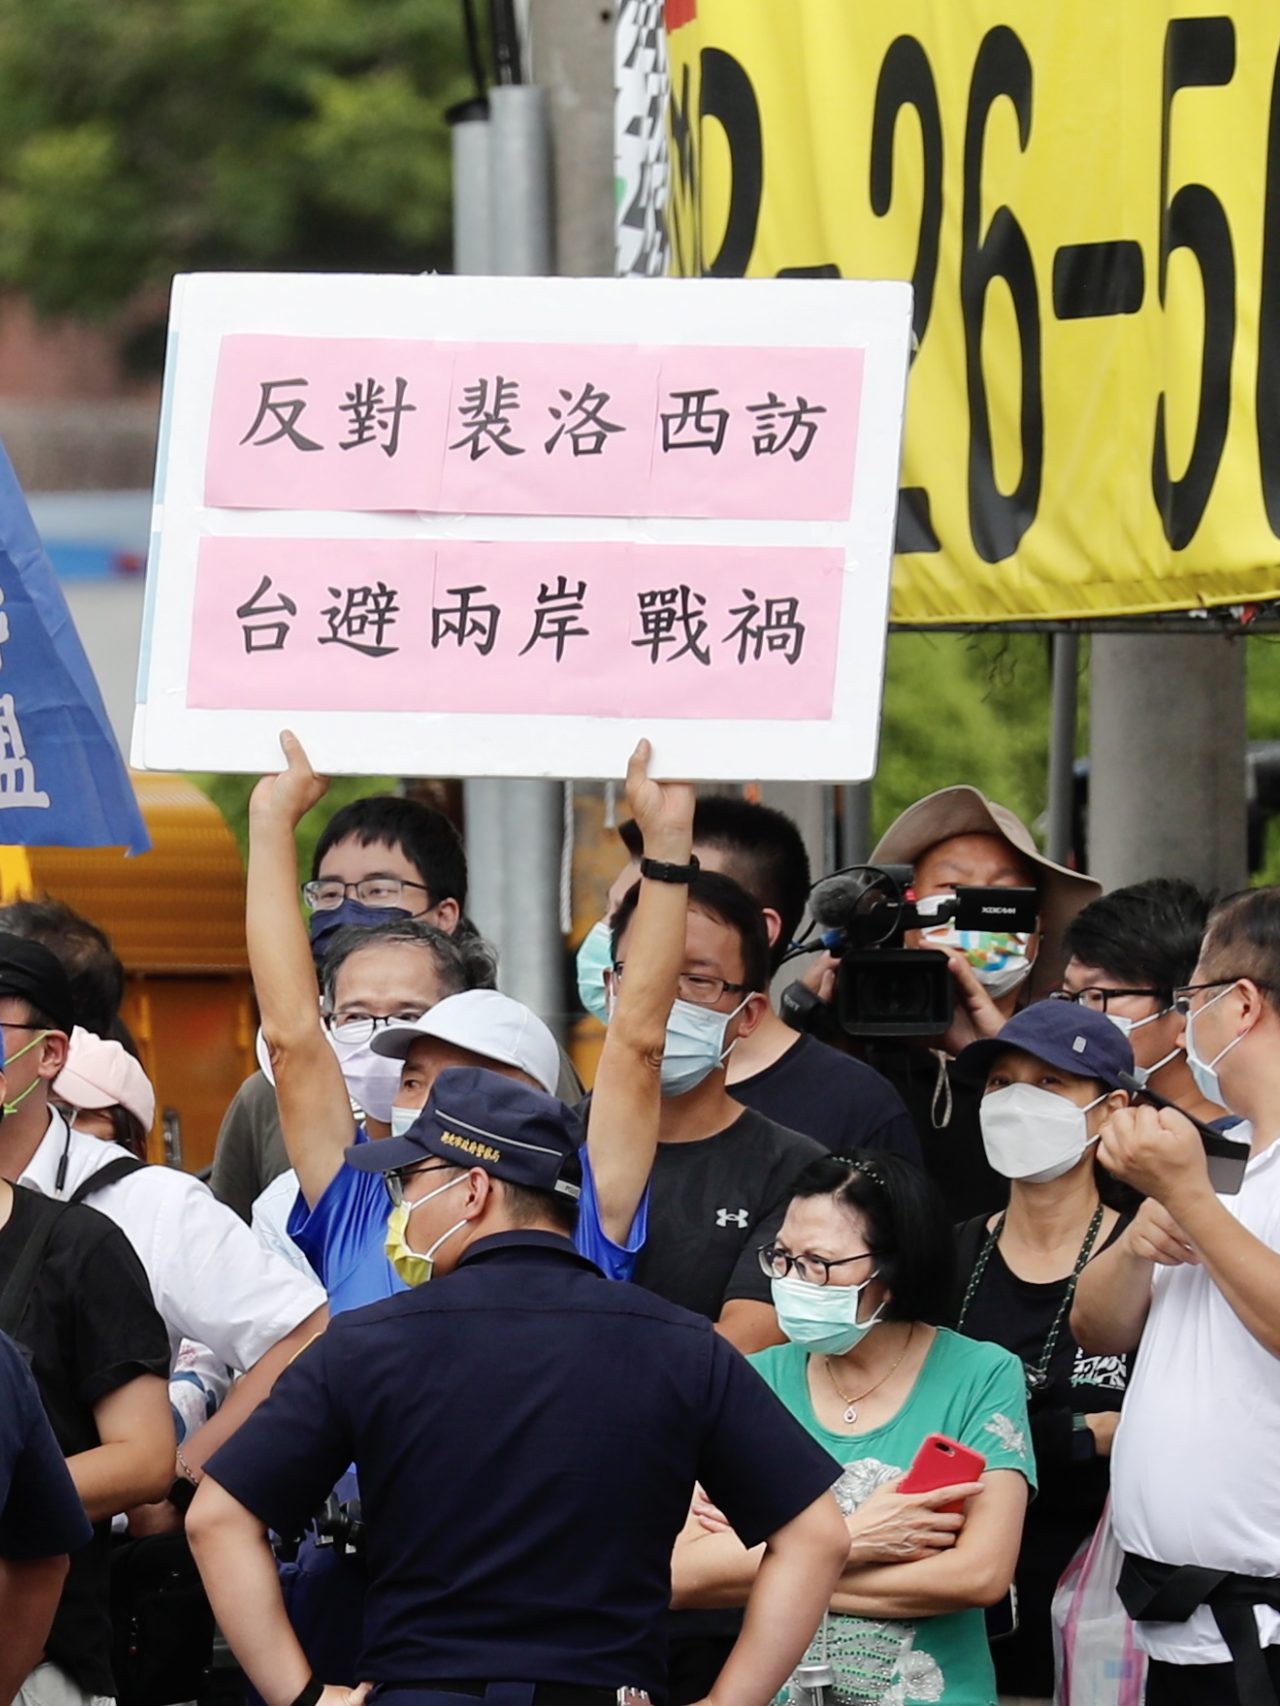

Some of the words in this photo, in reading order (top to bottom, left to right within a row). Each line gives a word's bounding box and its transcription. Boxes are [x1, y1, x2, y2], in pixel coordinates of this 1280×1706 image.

[239, 375, 827, 462] 反對裴洛西訪
[236, 575, 806, 666] 台避兩岸戰禍
